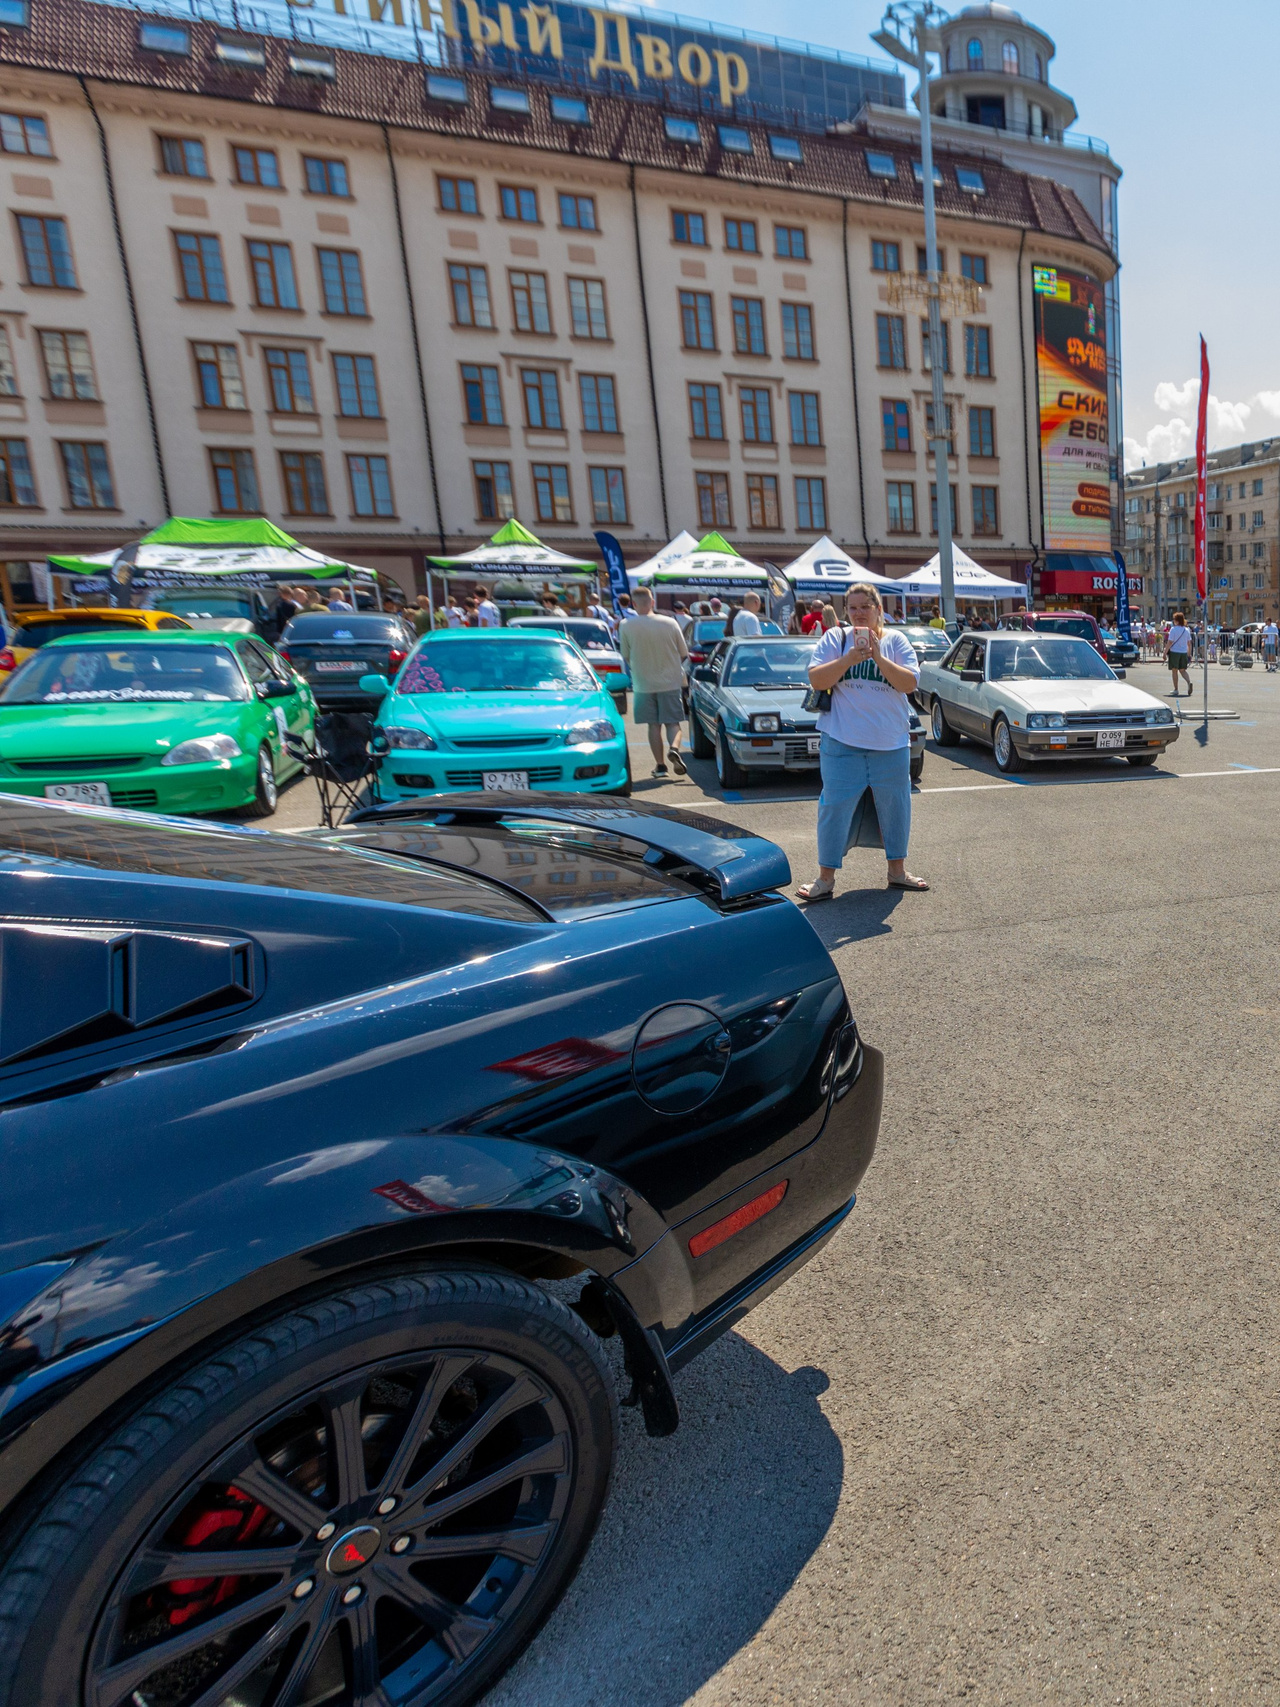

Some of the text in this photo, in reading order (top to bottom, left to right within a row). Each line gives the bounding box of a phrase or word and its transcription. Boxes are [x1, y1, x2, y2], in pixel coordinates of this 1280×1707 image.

[589, 9, 749, 108] Двор
[1062, 446, 1084, 457] ДЛЯ
[932, 570, 987, 578] Pide
[687, 577, 762, 586] ALPHARD GROUP
[844, 682, 891, 693] NEW YORK
[501, 773, 522, 782] 713
[72, 784, 99, 797] 789
[519, 1319, 602, 1400] SUNFULL
